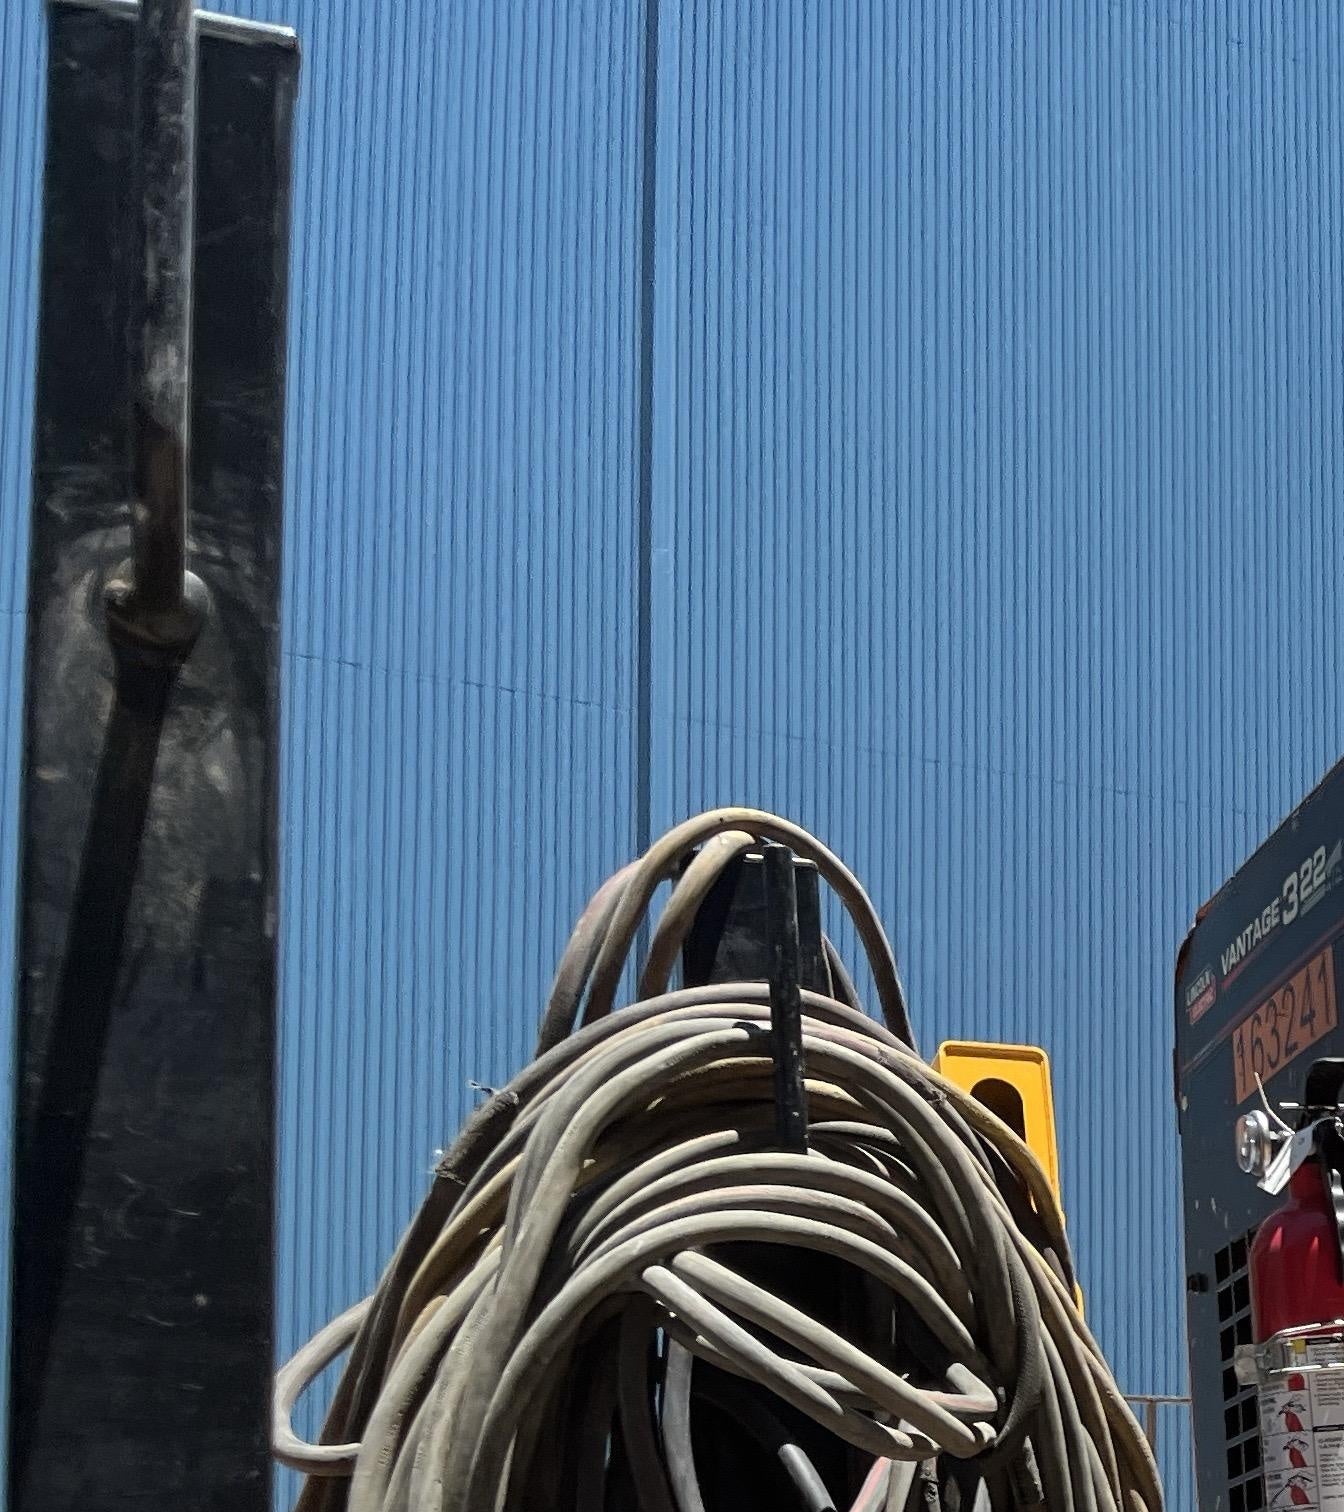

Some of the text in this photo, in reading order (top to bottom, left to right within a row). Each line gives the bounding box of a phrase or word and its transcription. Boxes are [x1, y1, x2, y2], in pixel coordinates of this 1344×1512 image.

[1220, 896, 1281, 976] VANTAGE
[1281, 845, 1327, 926] 322
[1235, 950, 1336, 1093] 163241
